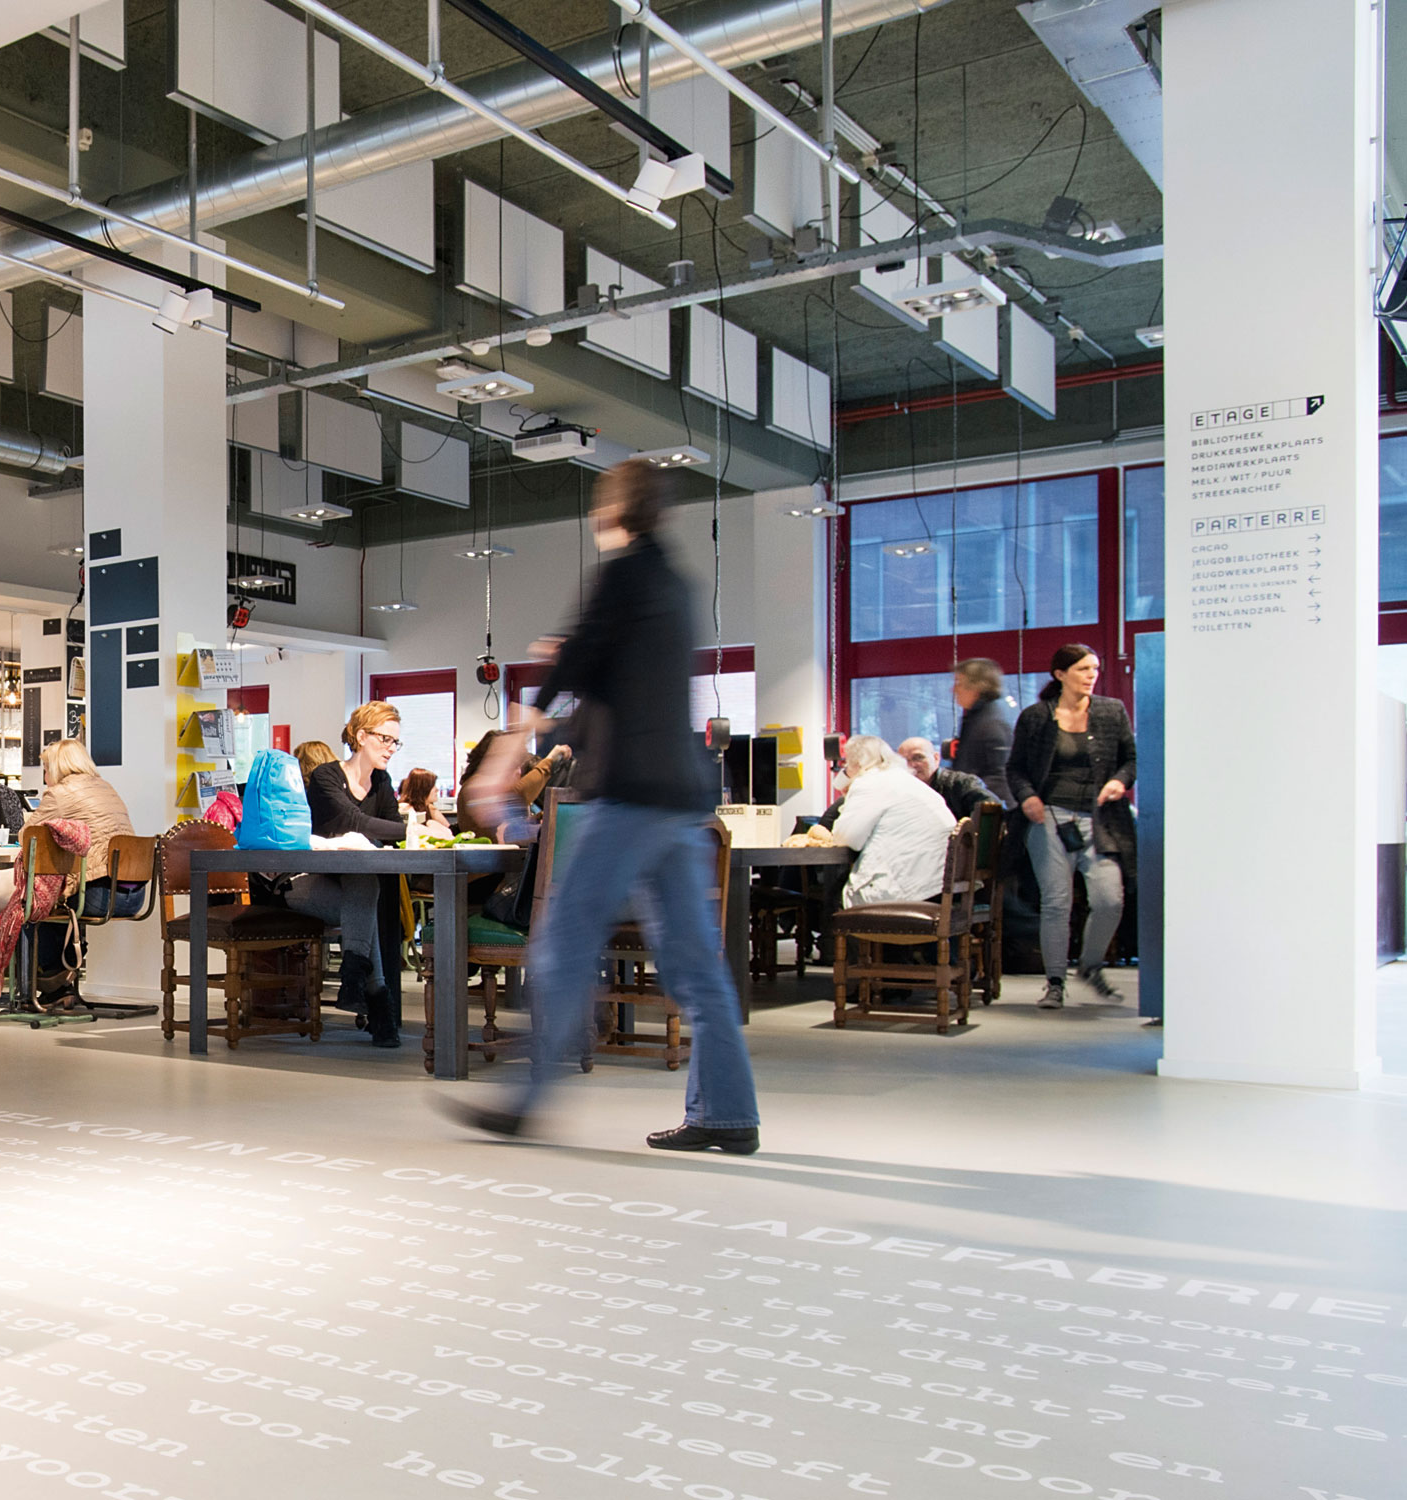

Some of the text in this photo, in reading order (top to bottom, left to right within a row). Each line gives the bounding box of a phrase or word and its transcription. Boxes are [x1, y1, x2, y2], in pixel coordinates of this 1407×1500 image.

[1195, 406, 1270, 427] ETAGE
[1191, 431, 1264, 447] BIBLIOTHEEK
[1191, 437, 1324, 460] DRUKKERSWERKPLAATS
[1191, 453, 1300, 473] MEDIAWERKPLAATS
[1191, 476, 1220, 487] MELK
[1230, 473, 1251, 482] WIT
[1261, 468, 1292, 478] PUUR
[1192, 483, 1281, 500] STREEKARCHIEF
[1195, 509, 1321, 532] PARTERRE
[1191, 543, 1229, 554] CACAO
[1192, 550, 1300, 568] JEUGDBIBLIOTHEEK
[1192, 564, 1299, 581] JEUGDWERKPLAATS
[1192, 583, 1227, 593] KRUIM
[1192, 597, 1228, 606] LADEN
[1238, 593, 1281, 603] LOSSEN
[1192, 606, 1286, 619] STEENLANDZAAL
[1192, 622, 1252, 632] TOILETTEN
[187, 1141, 269, 1155] IN
[266, 1151, 377, 1172] DE
[382, 1167, 1407, 1329] CHOCOLADEFABRIE
[280, 1179, 352, 1195] van
[376, 1195, 682, 1249] bestemming
[712, 1248, 862, 1277] bent
[907, 1279, 1365, 1356] aangekomen
[317, 1204, 497, 1237] gebouw
[535, 1239, 666, 1265] voor
[704, 1268, 781, 1285] je
[833, 1288, 998, 1320] ziet
[1059, 1325, 1407, 1387] oprijze
[331, 1225, 427, 1246] met
[453, 1248, 524, 1263] je
[564, 1266, 706, 1296] ogen
[762, 1297, 834, 1317] te
[884, 1317, 1333, 1402] knipperen
[360, 1275, 541, 1314] stand
[569, 1315, 649, 1336] is
[688, 1338, 1127, 1425] gebracht?
[393, 1256, 495, 1281] het
[525, 1282, 847, 1345] mogelijk
[898, 1349, 1040, 1380] dat
[1101, 1384, 1204, 1408] zo
[1275, 1412, 1407, 1442] ie
[222, 1303, 368, 1337] glas
[432, 1345, 806, 1437] voorzien.
[79, 1297, 545, 1415] voorzieningen
[622, 1421, 892, 1495] heeft
[345, 1299, 1052, 1450] air-conditioning
[1108, 1452, 1225, 1483] en
[187, 1400, 351, 1450] voor
[382, 1450, 540, 1500] het
[489, 1432, 771, 1500] volko
